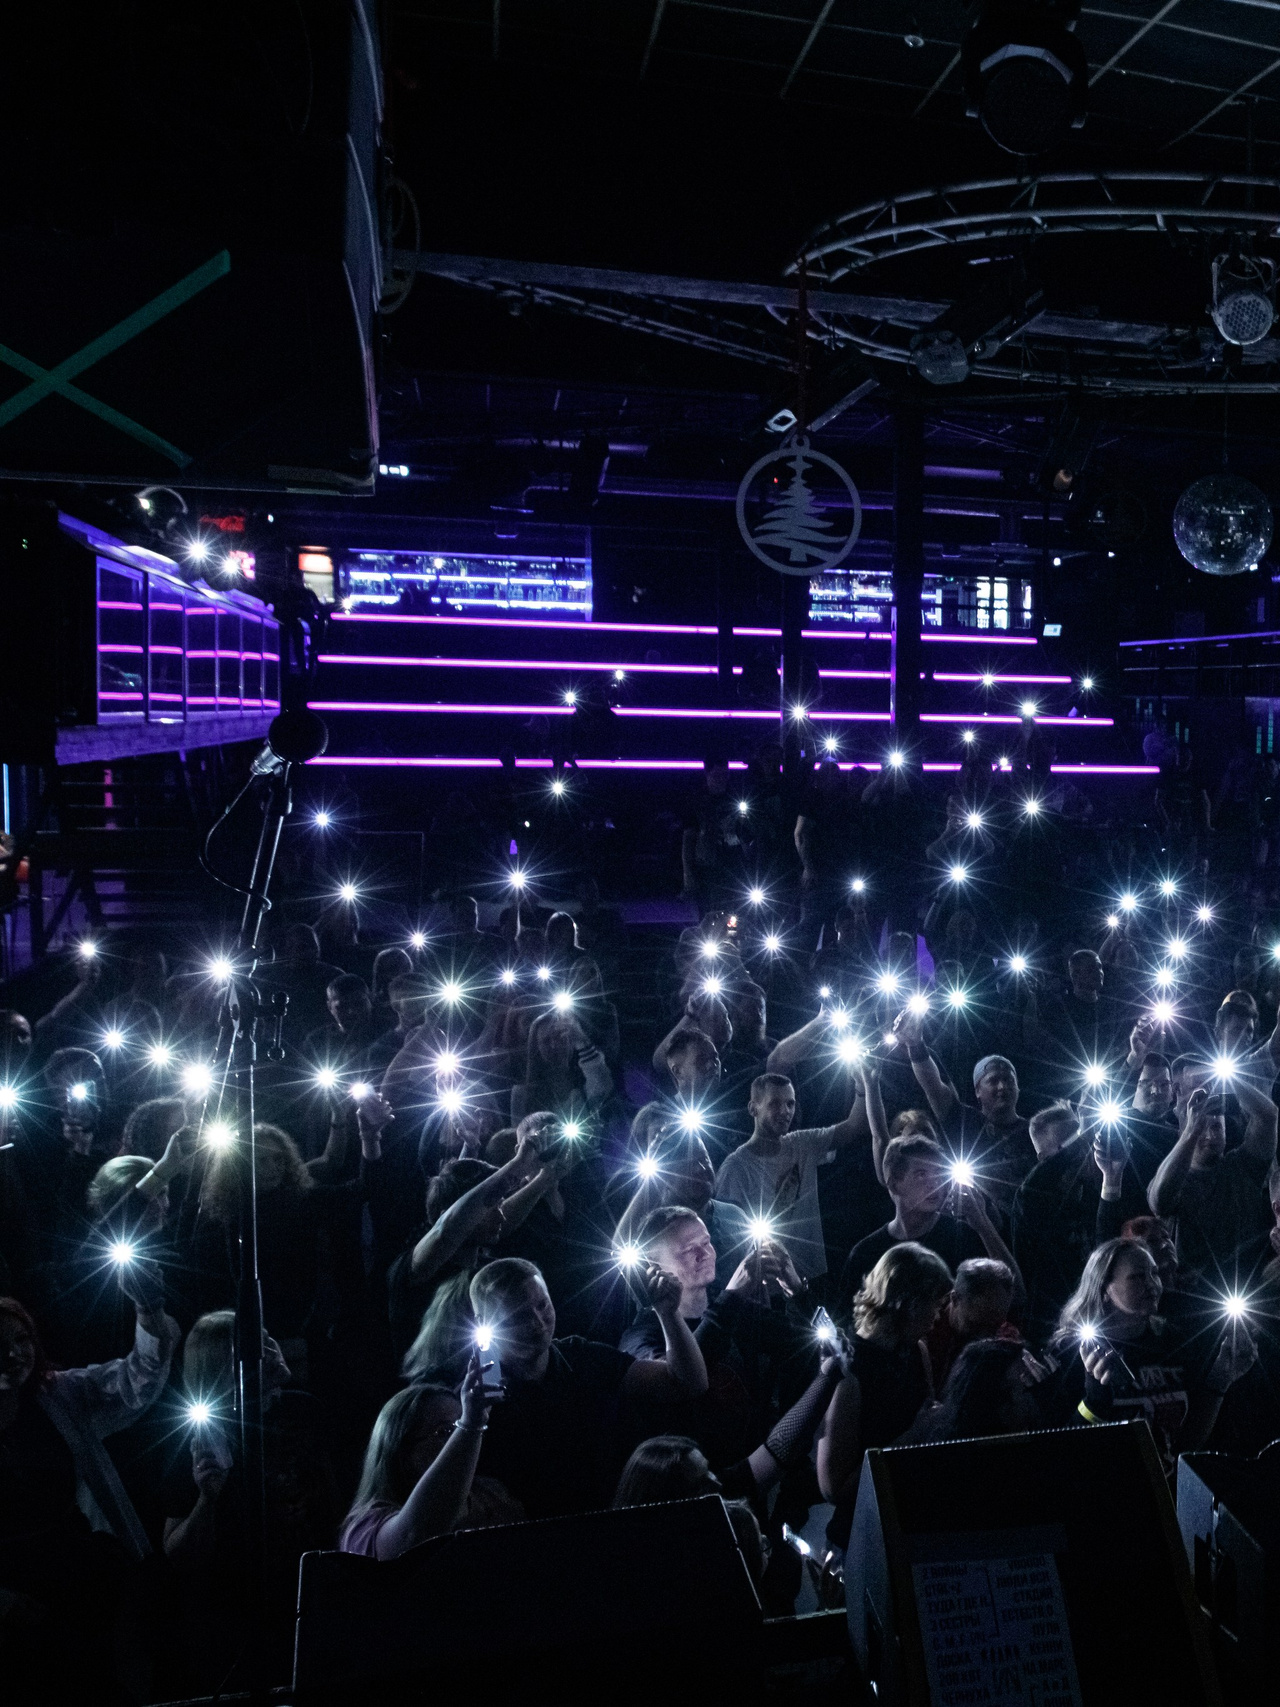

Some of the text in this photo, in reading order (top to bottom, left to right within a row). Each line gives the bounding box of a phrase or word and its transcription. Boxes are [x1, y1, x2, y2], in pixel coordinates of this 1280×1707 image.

[923, 1568, 929, 1580] 2
[928, 1600, 955, 1614] ТУДА
[957, 1597, 977, 1611] ГДЕ
[931, 1613, 980, 1631] 3 СЕСТРЫ
[1030, 1640, 1062, 1655] КЕННИ
[1023, 1658, 1066, 1675] НА МАРС
[939, 1669, 981, 1687] 200 КВТ
[942, 1687, 990, 1704] ЧЕРНУХА
